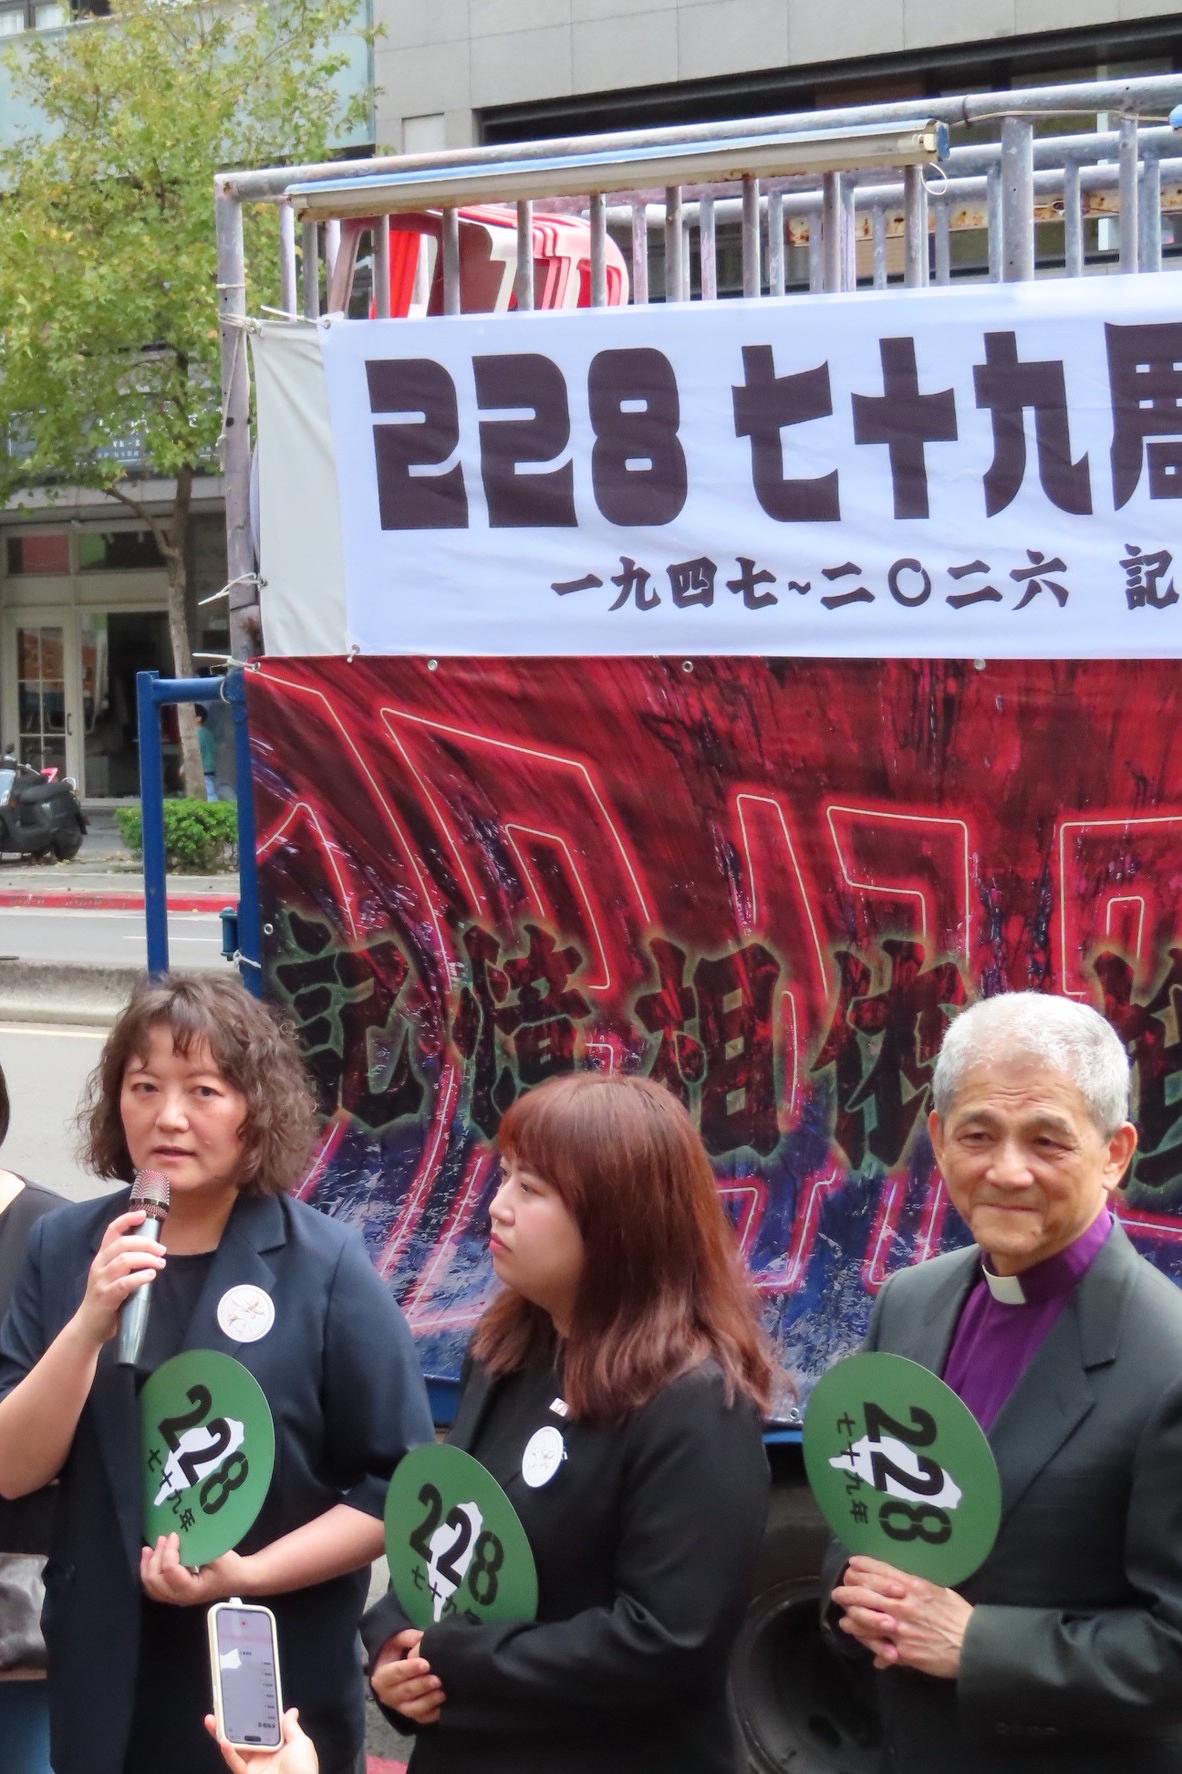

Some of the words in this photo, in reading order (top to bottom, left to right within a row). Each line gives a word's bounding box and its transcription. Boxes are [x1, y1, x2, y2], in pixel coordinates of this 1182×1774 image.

[147, 1448, 196, 1533] 七十九年
[158, 1383, 249, 1515] 228
[836, 1411, 869, 1525] 七十九年
[863, 1401, 953, 1545] 228
[409, 1482, 505, 1606] 228
